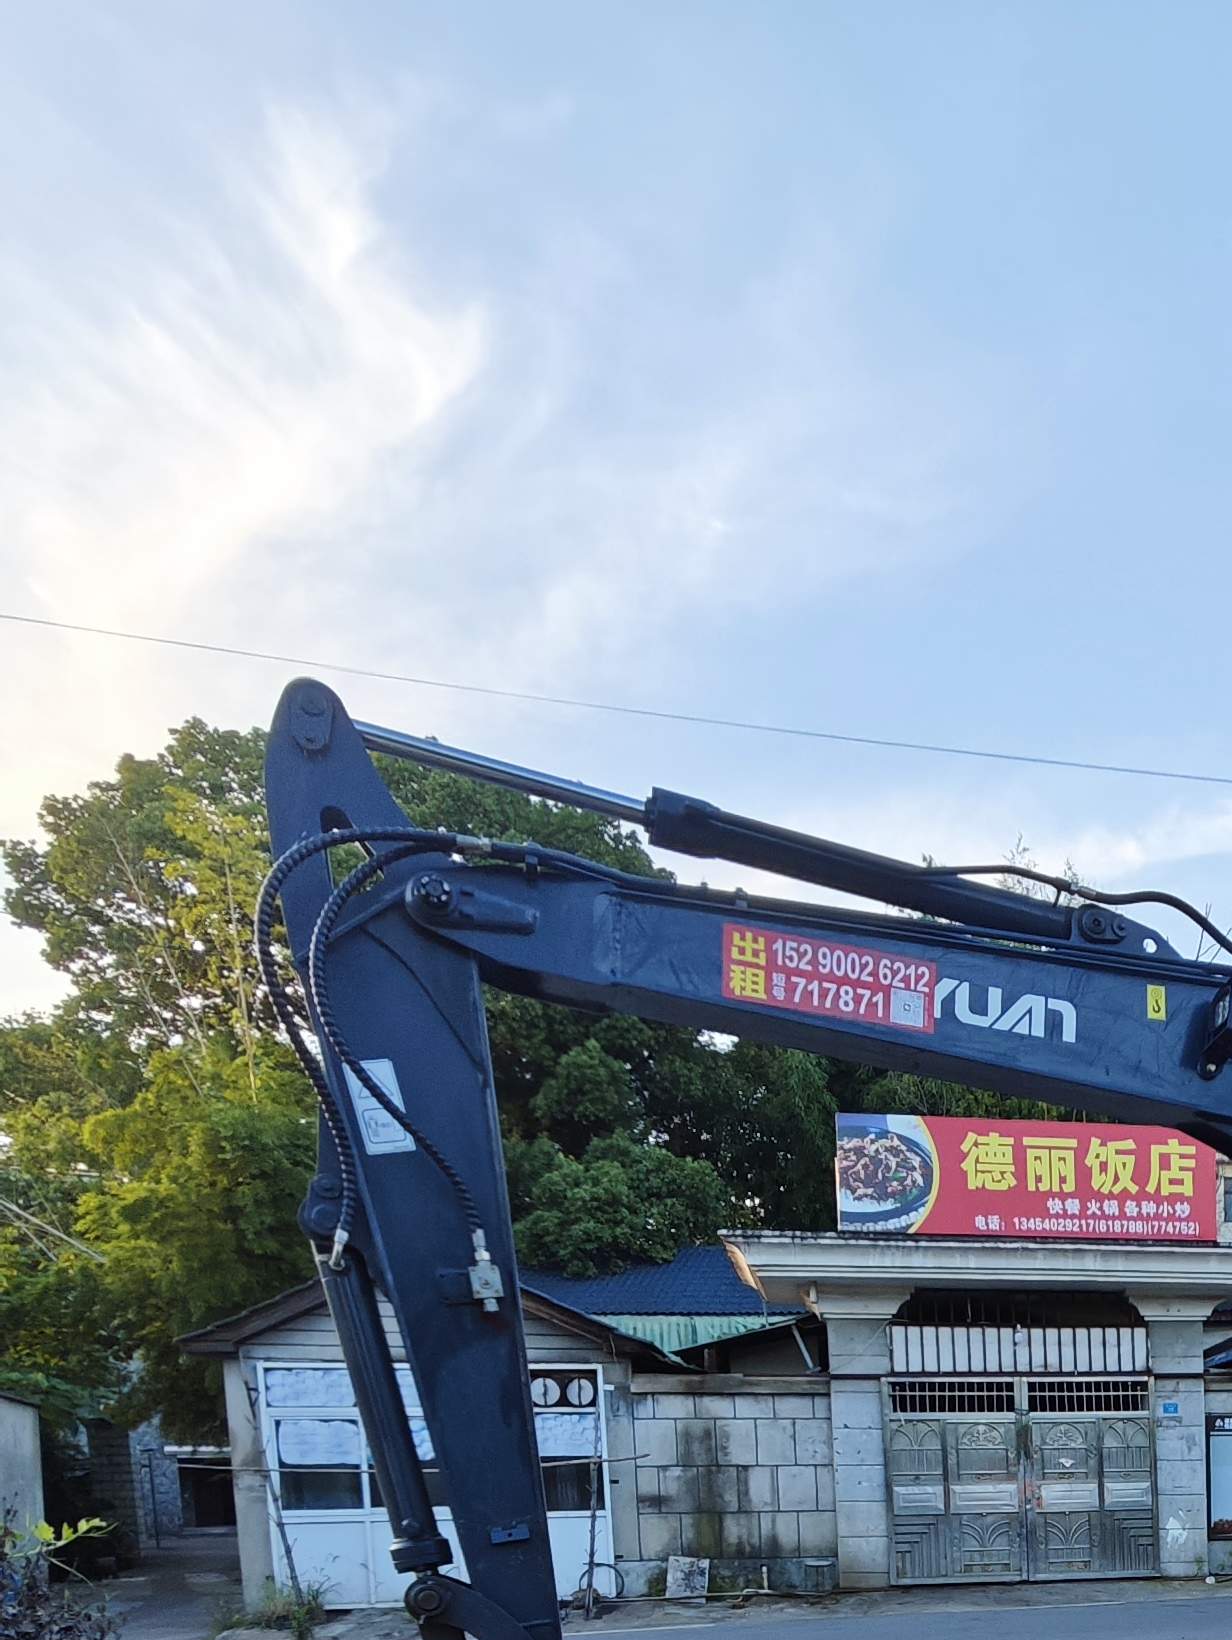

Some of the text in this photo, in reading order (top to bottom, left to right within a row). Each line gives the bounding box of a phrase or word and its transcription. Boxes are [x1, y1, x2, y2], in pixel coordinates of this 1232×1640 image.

[730, 930, 767, 1000] 出租
[772, 938, 930, 993] 152 9002 6212
[790, 975, 884, 1018] 717871
[960, 1131, 1197, 1197] 德丽饭店
[1047, 1197, 1191, 1218] 快餐 火锅 各种小炒
